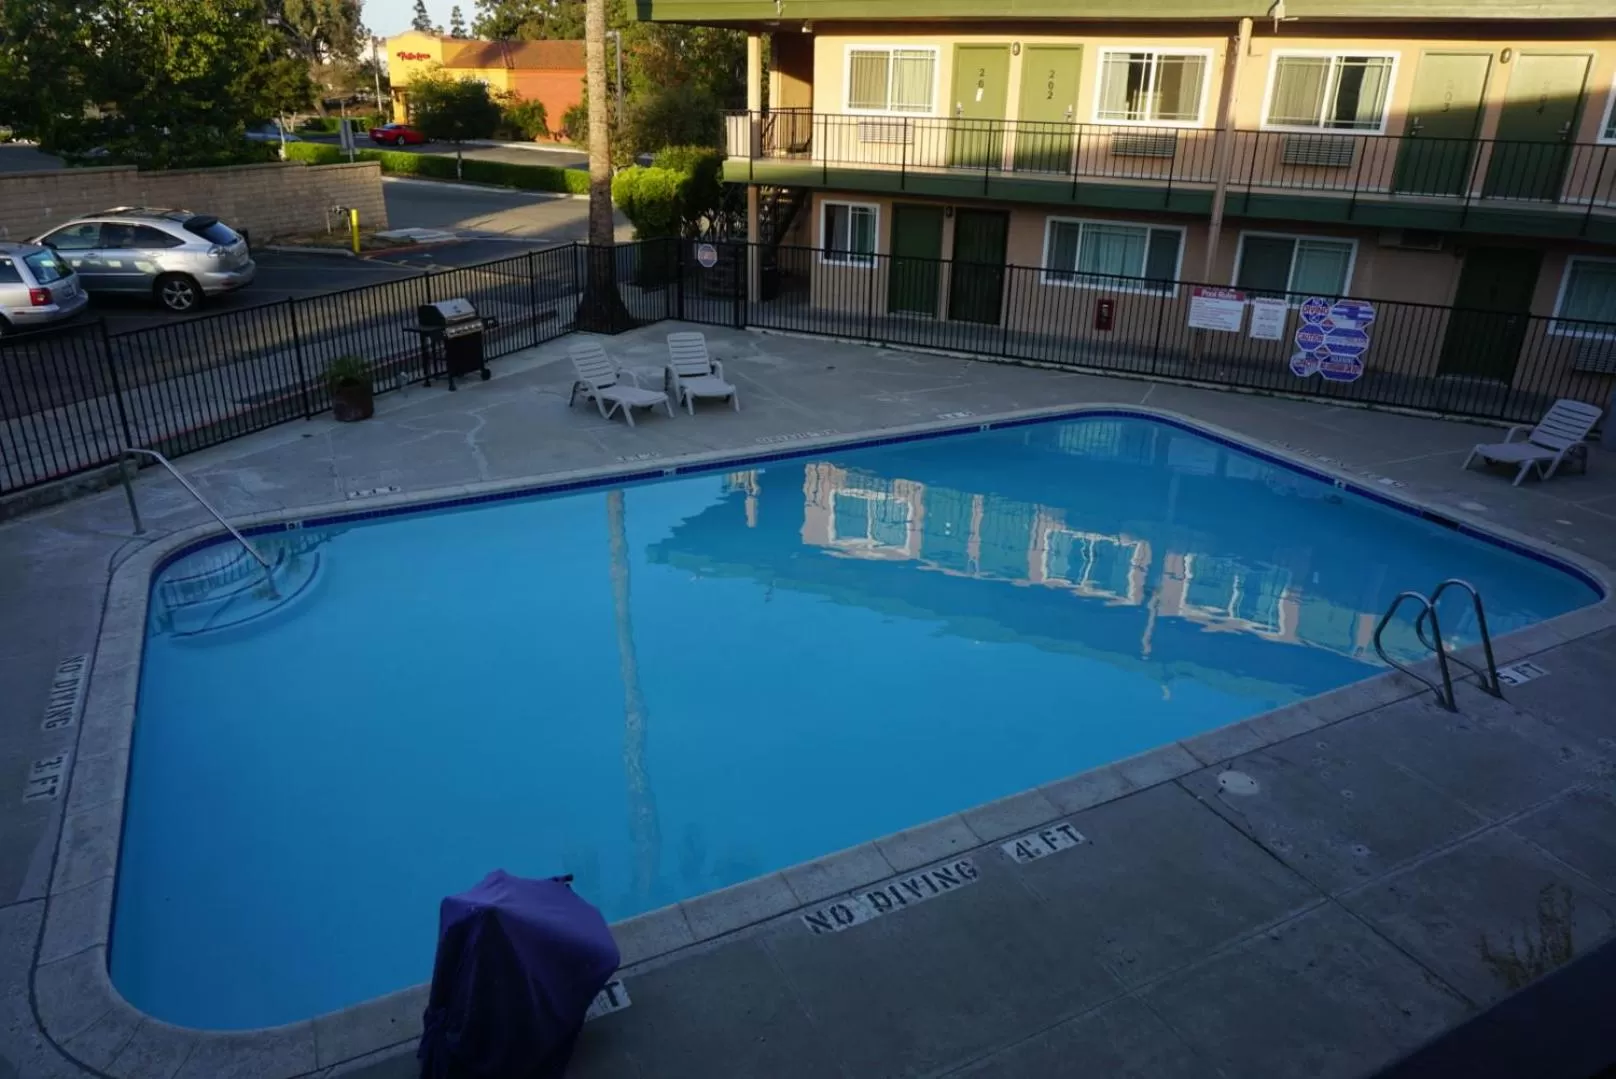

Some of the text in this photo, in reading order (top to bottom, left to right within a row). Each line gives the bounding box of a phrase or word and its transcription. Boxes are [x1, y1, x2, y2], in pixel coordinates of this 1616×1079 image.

[1046, 69, 1056, 100] 202
[1202, 289, 1217, 297] Pool
[44, 655, 83, 729] NO DIVING
[1039, 824, 1080, 850] FT
[804, 861, 978, 934] NO DIVING
